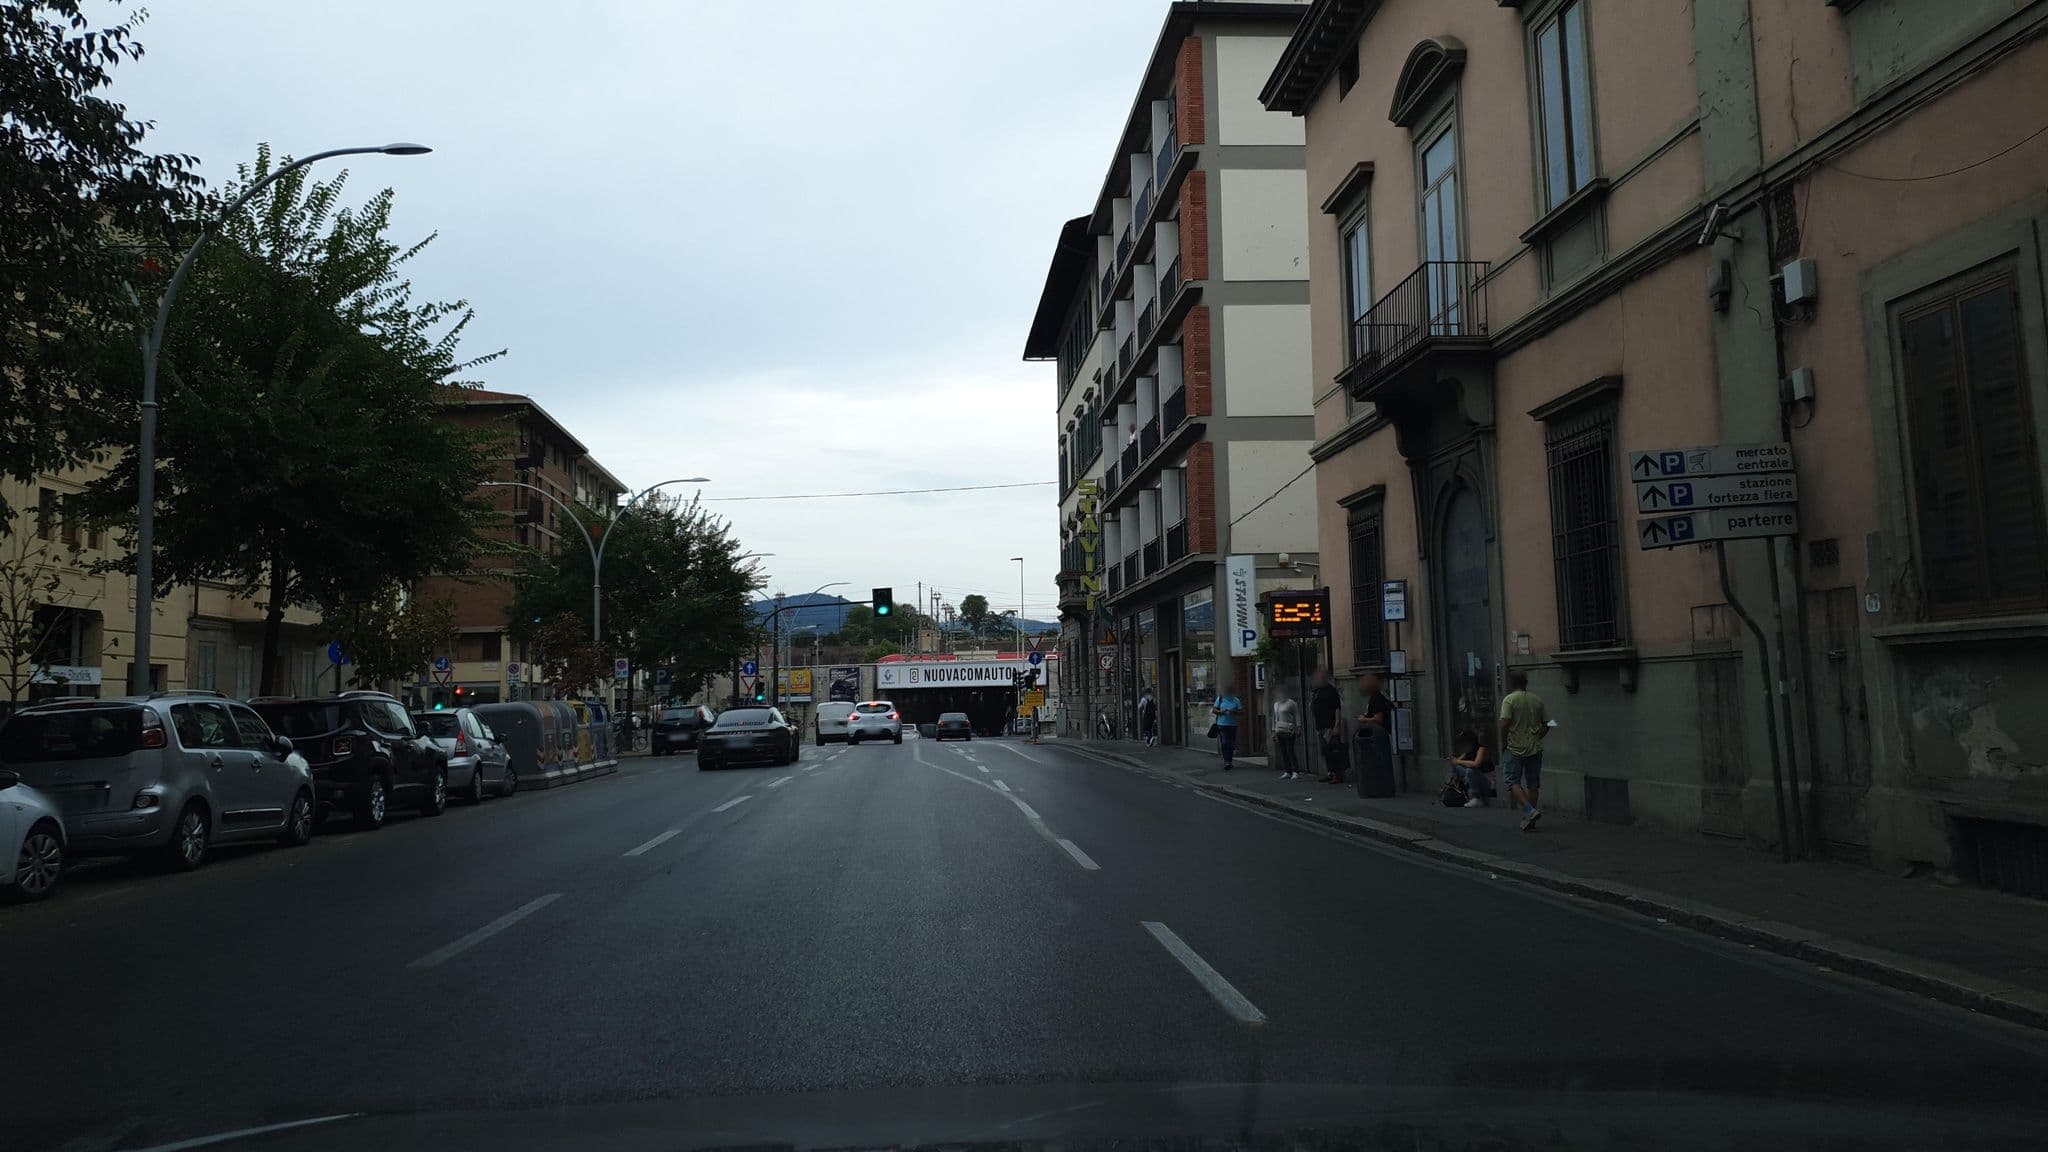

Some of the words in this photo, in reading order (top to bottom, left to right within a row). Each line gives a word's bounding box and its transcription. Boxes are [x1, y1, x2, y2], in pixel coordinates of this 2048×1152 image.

[1736, 446, 1787, 457] mercato
[1737, 459, 1789, 470] centrale
[1739, 478, 1792, 489] stazione
[1708, 492, 1759, 503] fortezza
[1764, 489, 1793, 500] fiera
[1728, 513, 1793, 530] parterre
[1079, 479, 1101, 611] STAVINI
[1235, 578, 1248, 629] STAVINI
[1242, 629, 1257, 648] P
[924, 667, 1012, 682] NUOVACOMAUTO
